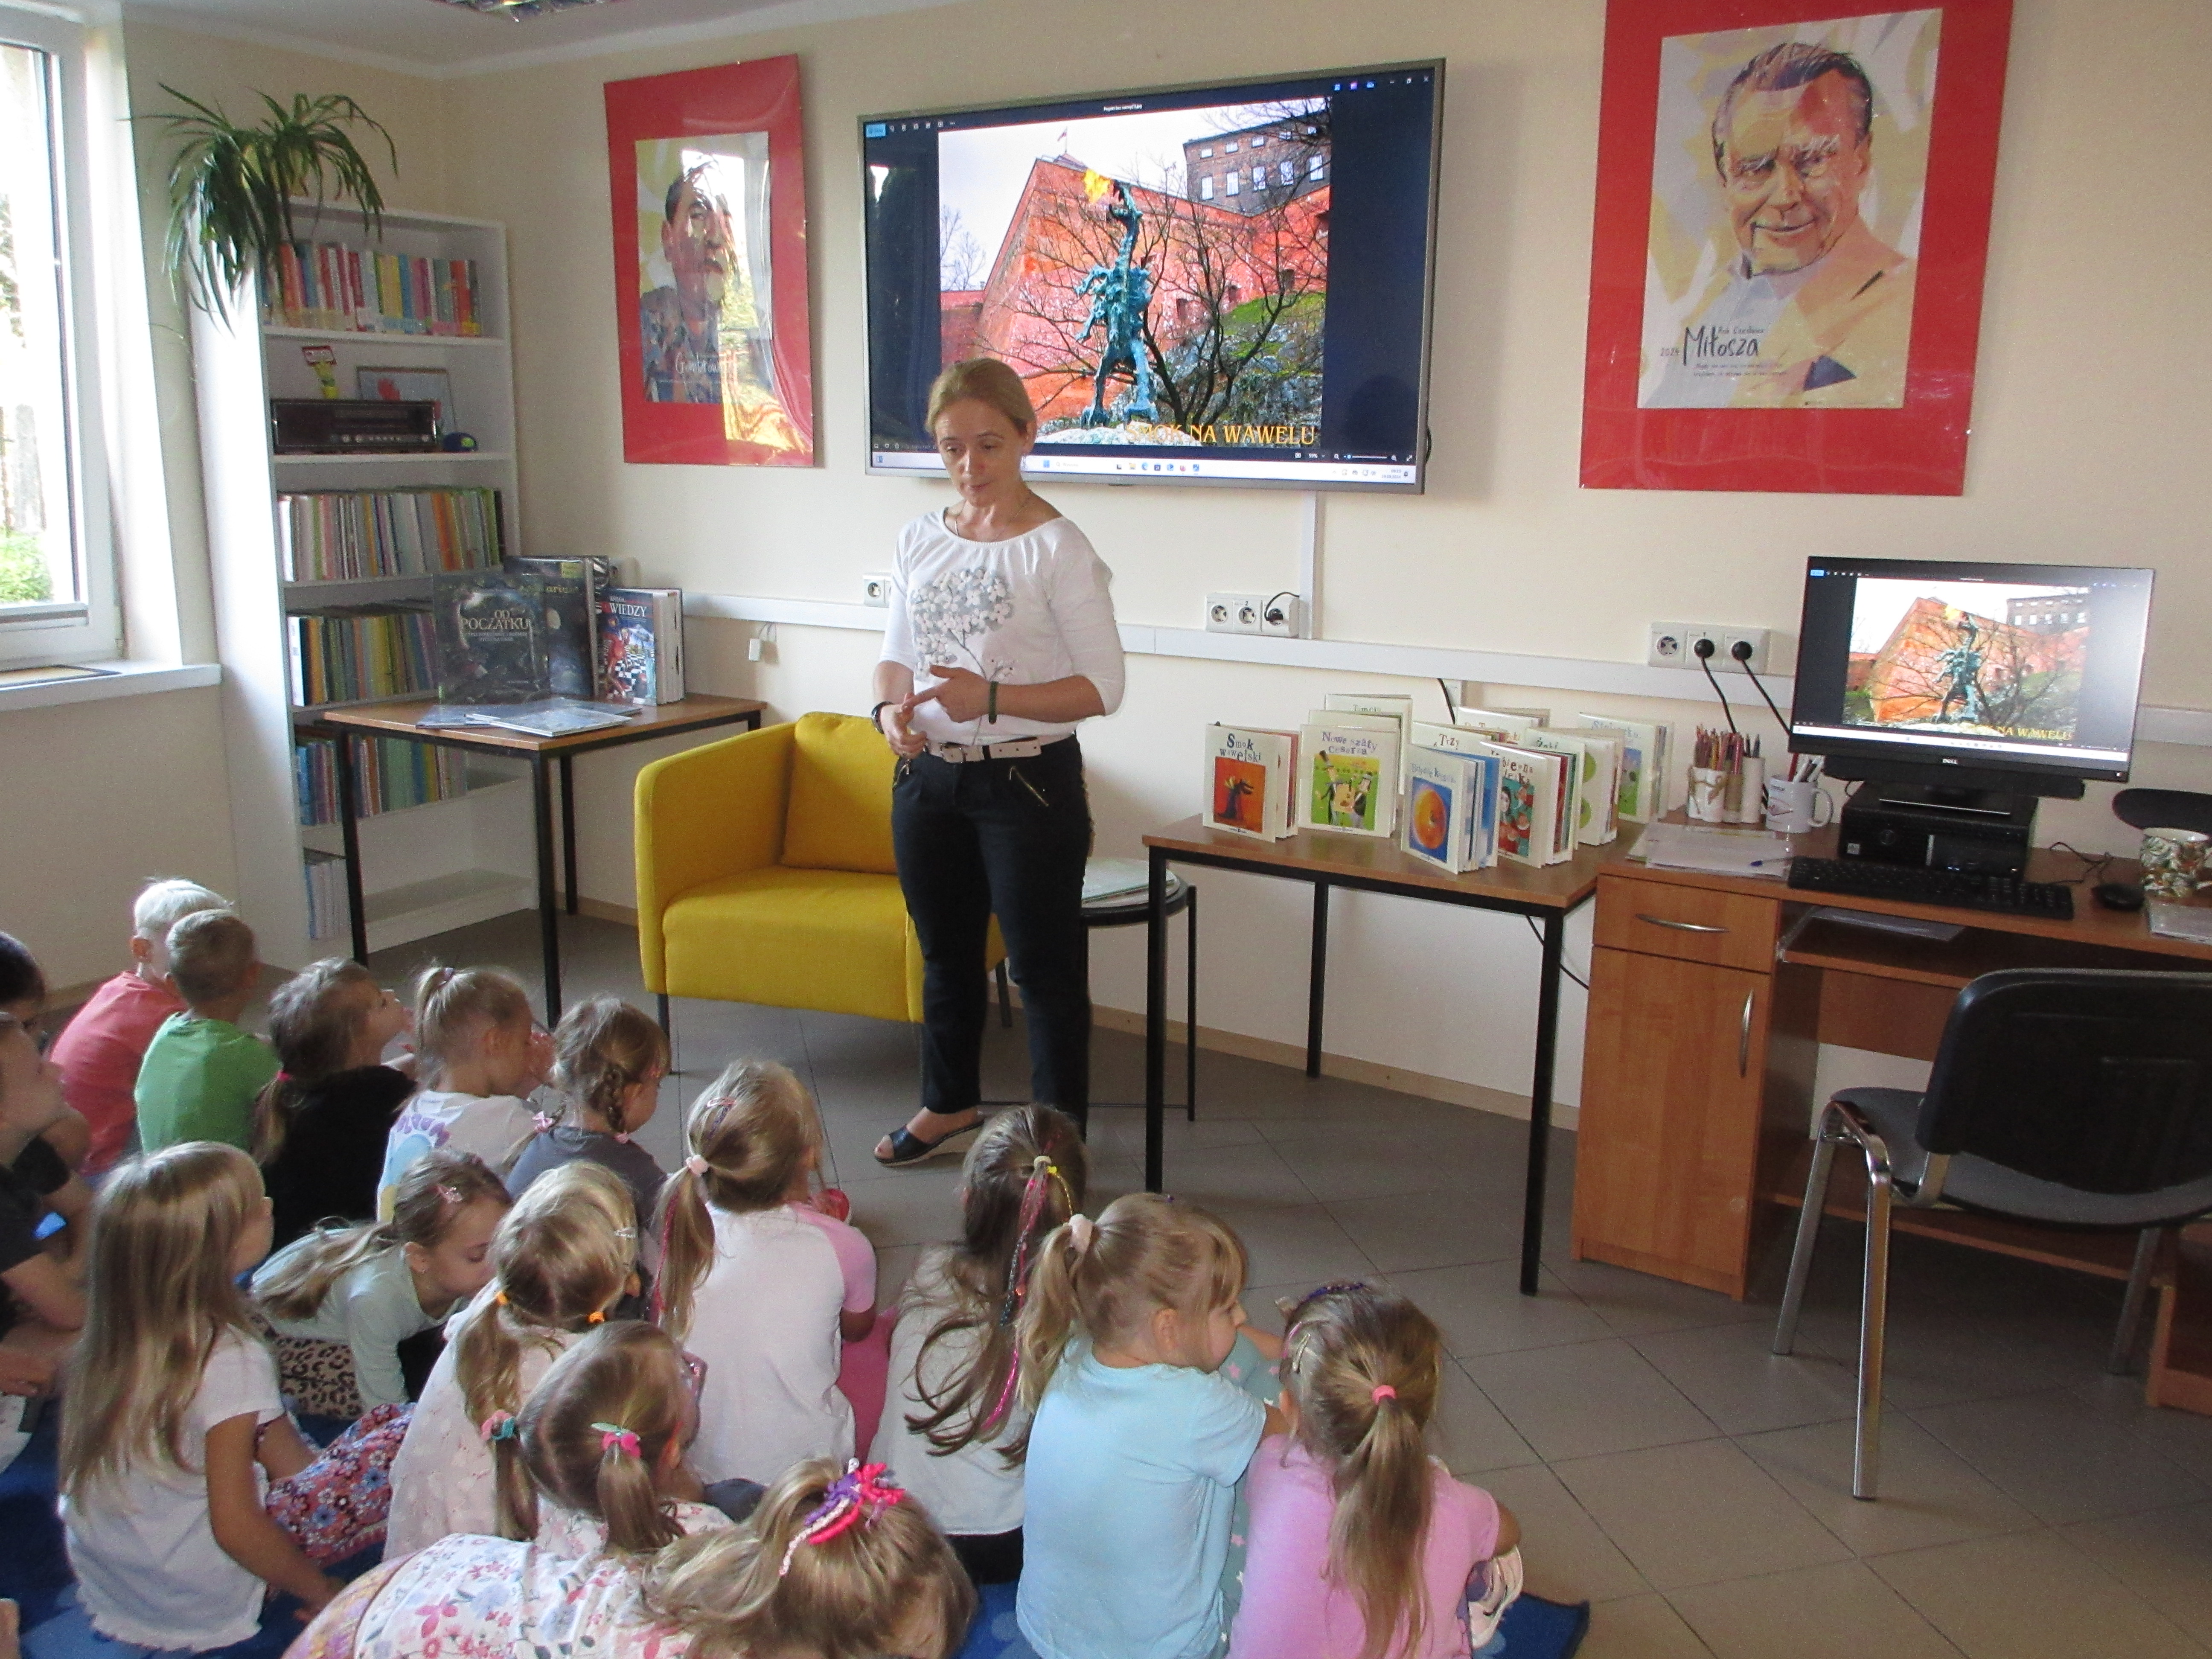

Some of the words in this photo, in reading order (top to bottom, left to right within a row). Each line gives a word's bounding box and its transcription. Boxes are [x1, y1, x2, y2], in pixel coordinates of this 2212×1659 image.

[1683, 326, 1758, 366] Miłosza
[1126, 424, 1183, 441] SMOK
[1190, 425, 1217, 442] NA
[1224, 425, 1315, 445] WAWELU
[495, 609, 510, 619] OD
[609, 602, 647, 617] WIEDZY
[461, 618, 529, 632] POCZĄTKU
[1227, 733, 1254, 751] Smok
[1322, 731, 1347, 744] Nowe
[1220, 748, 1261, 763] wawelski
